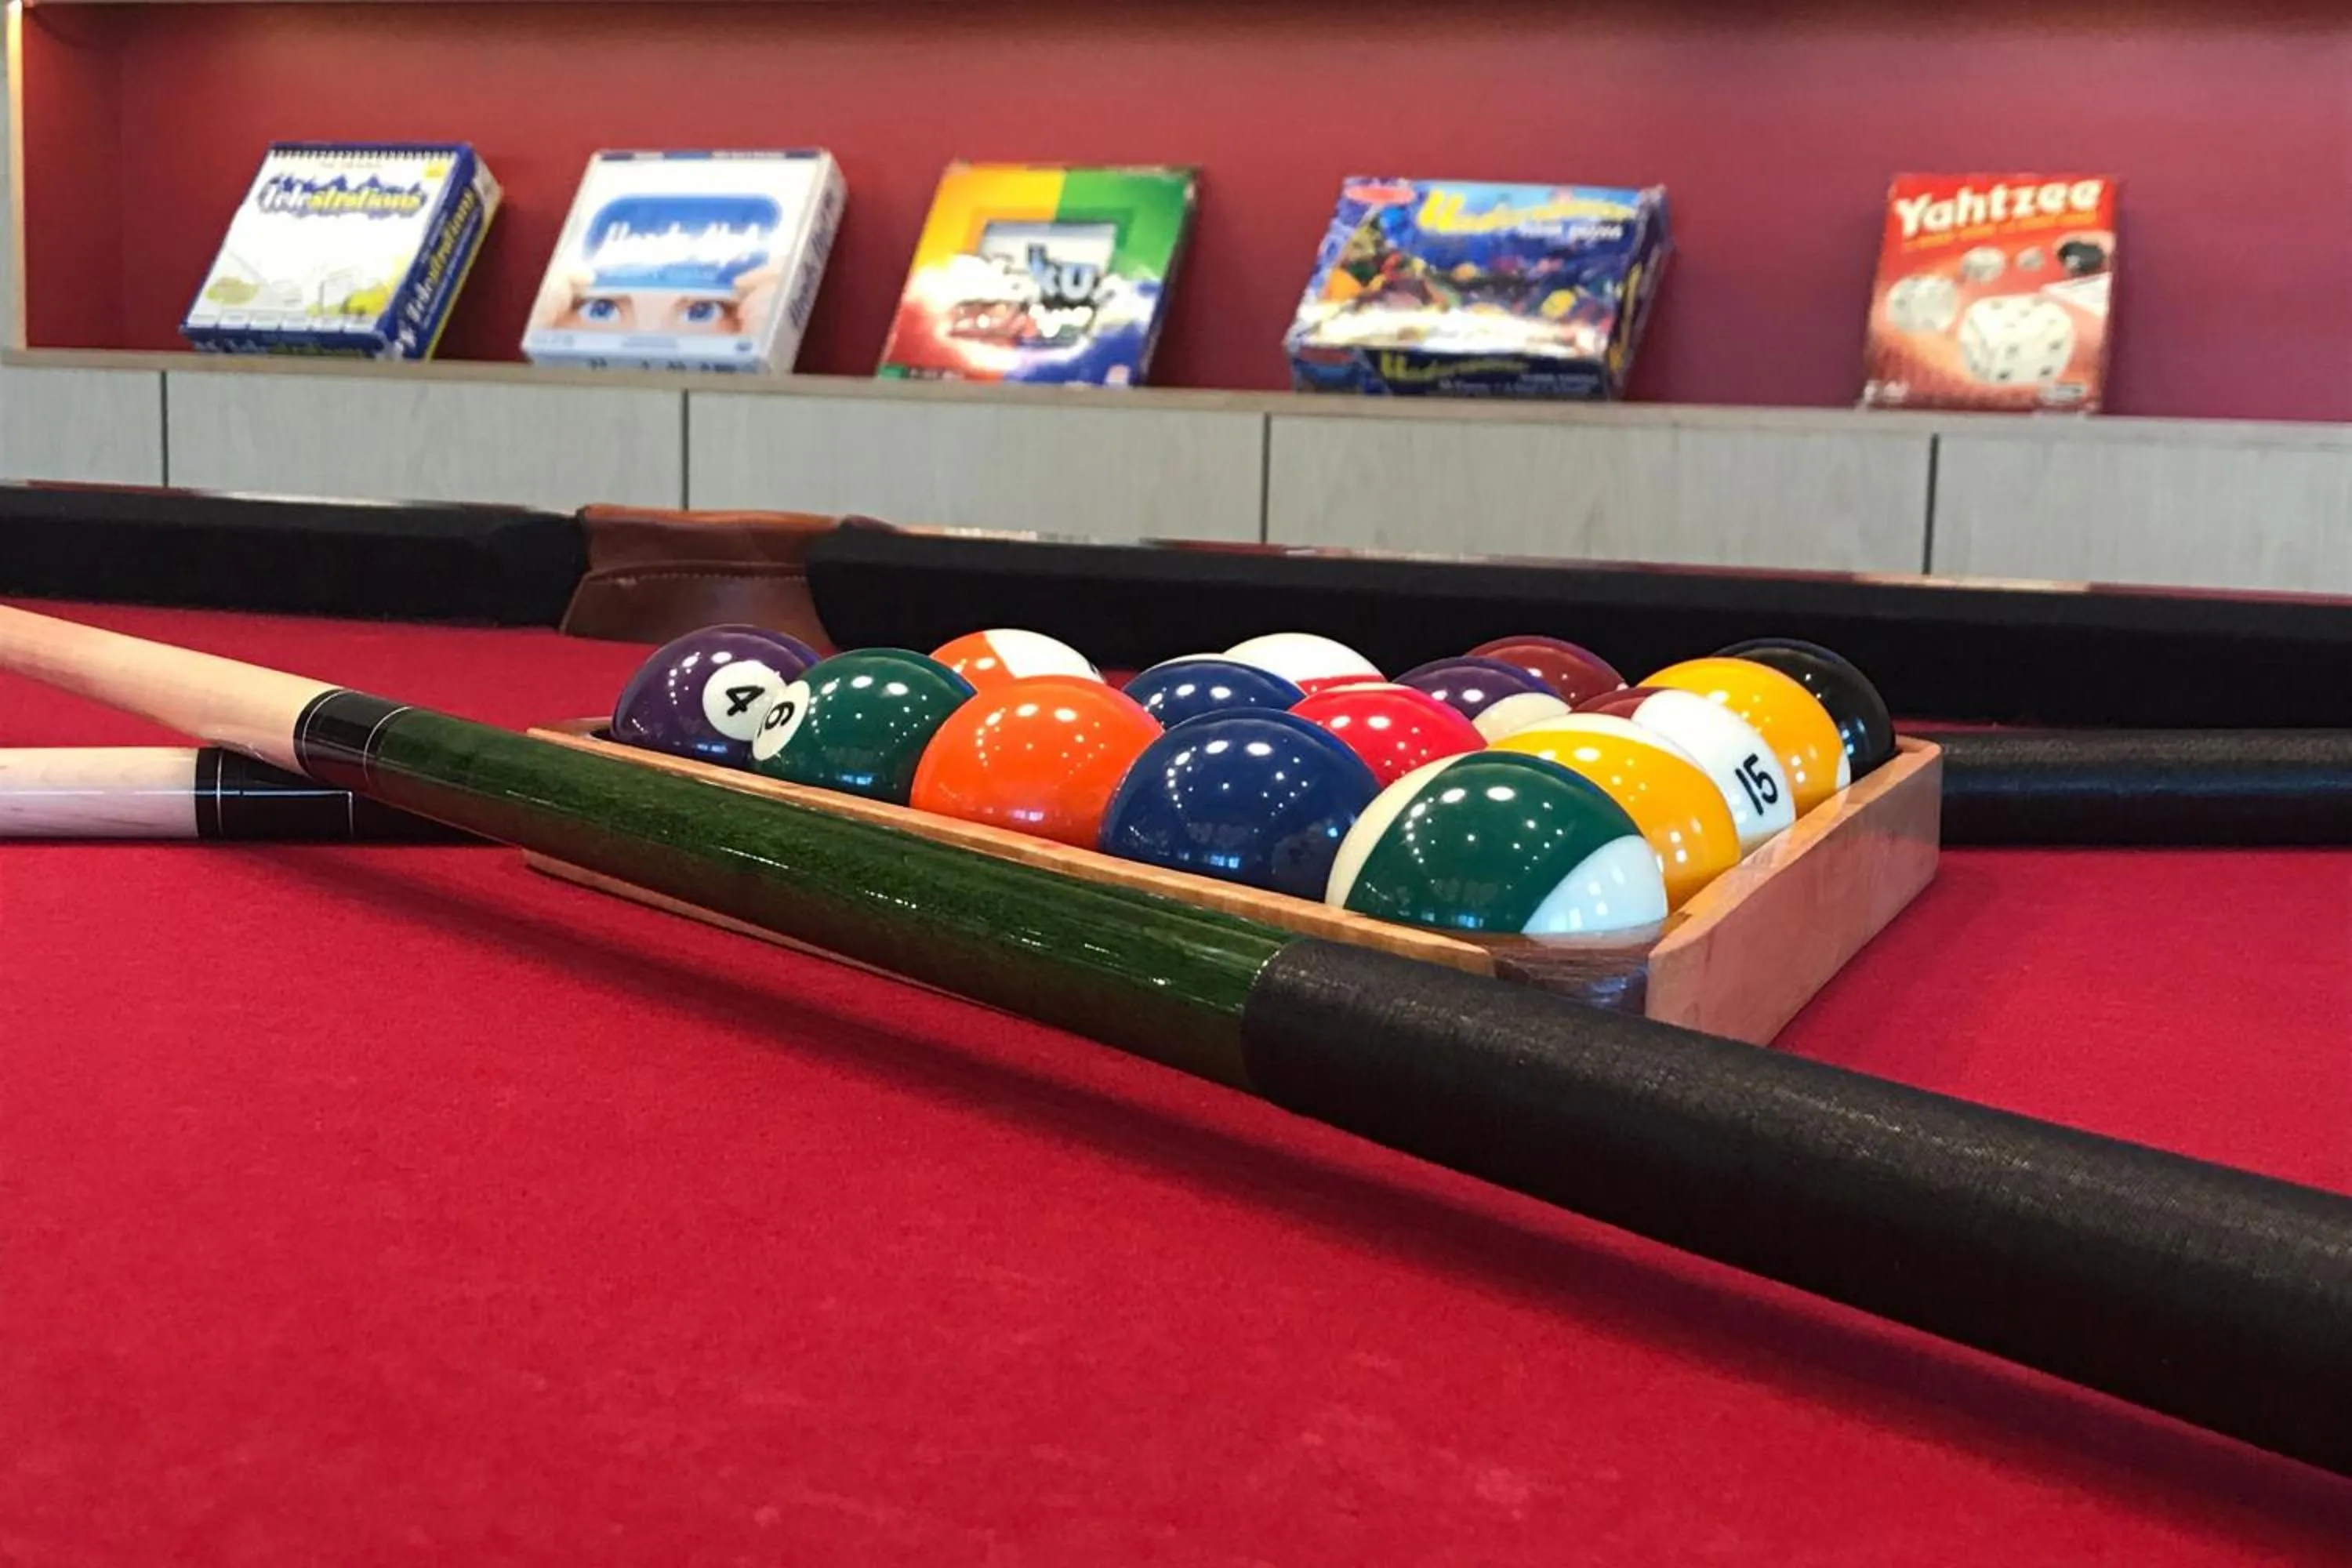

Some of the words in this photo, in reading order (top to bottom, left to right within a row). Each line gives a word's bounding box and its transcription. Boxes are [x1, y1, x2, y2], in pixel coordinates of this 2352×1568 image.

[1894, 180, 2104, 238] Yahtzee
[725, 685, 765, 717] 4
[764, 701, 795, 730] 6
[1735, 752, 1778, 816] 15
